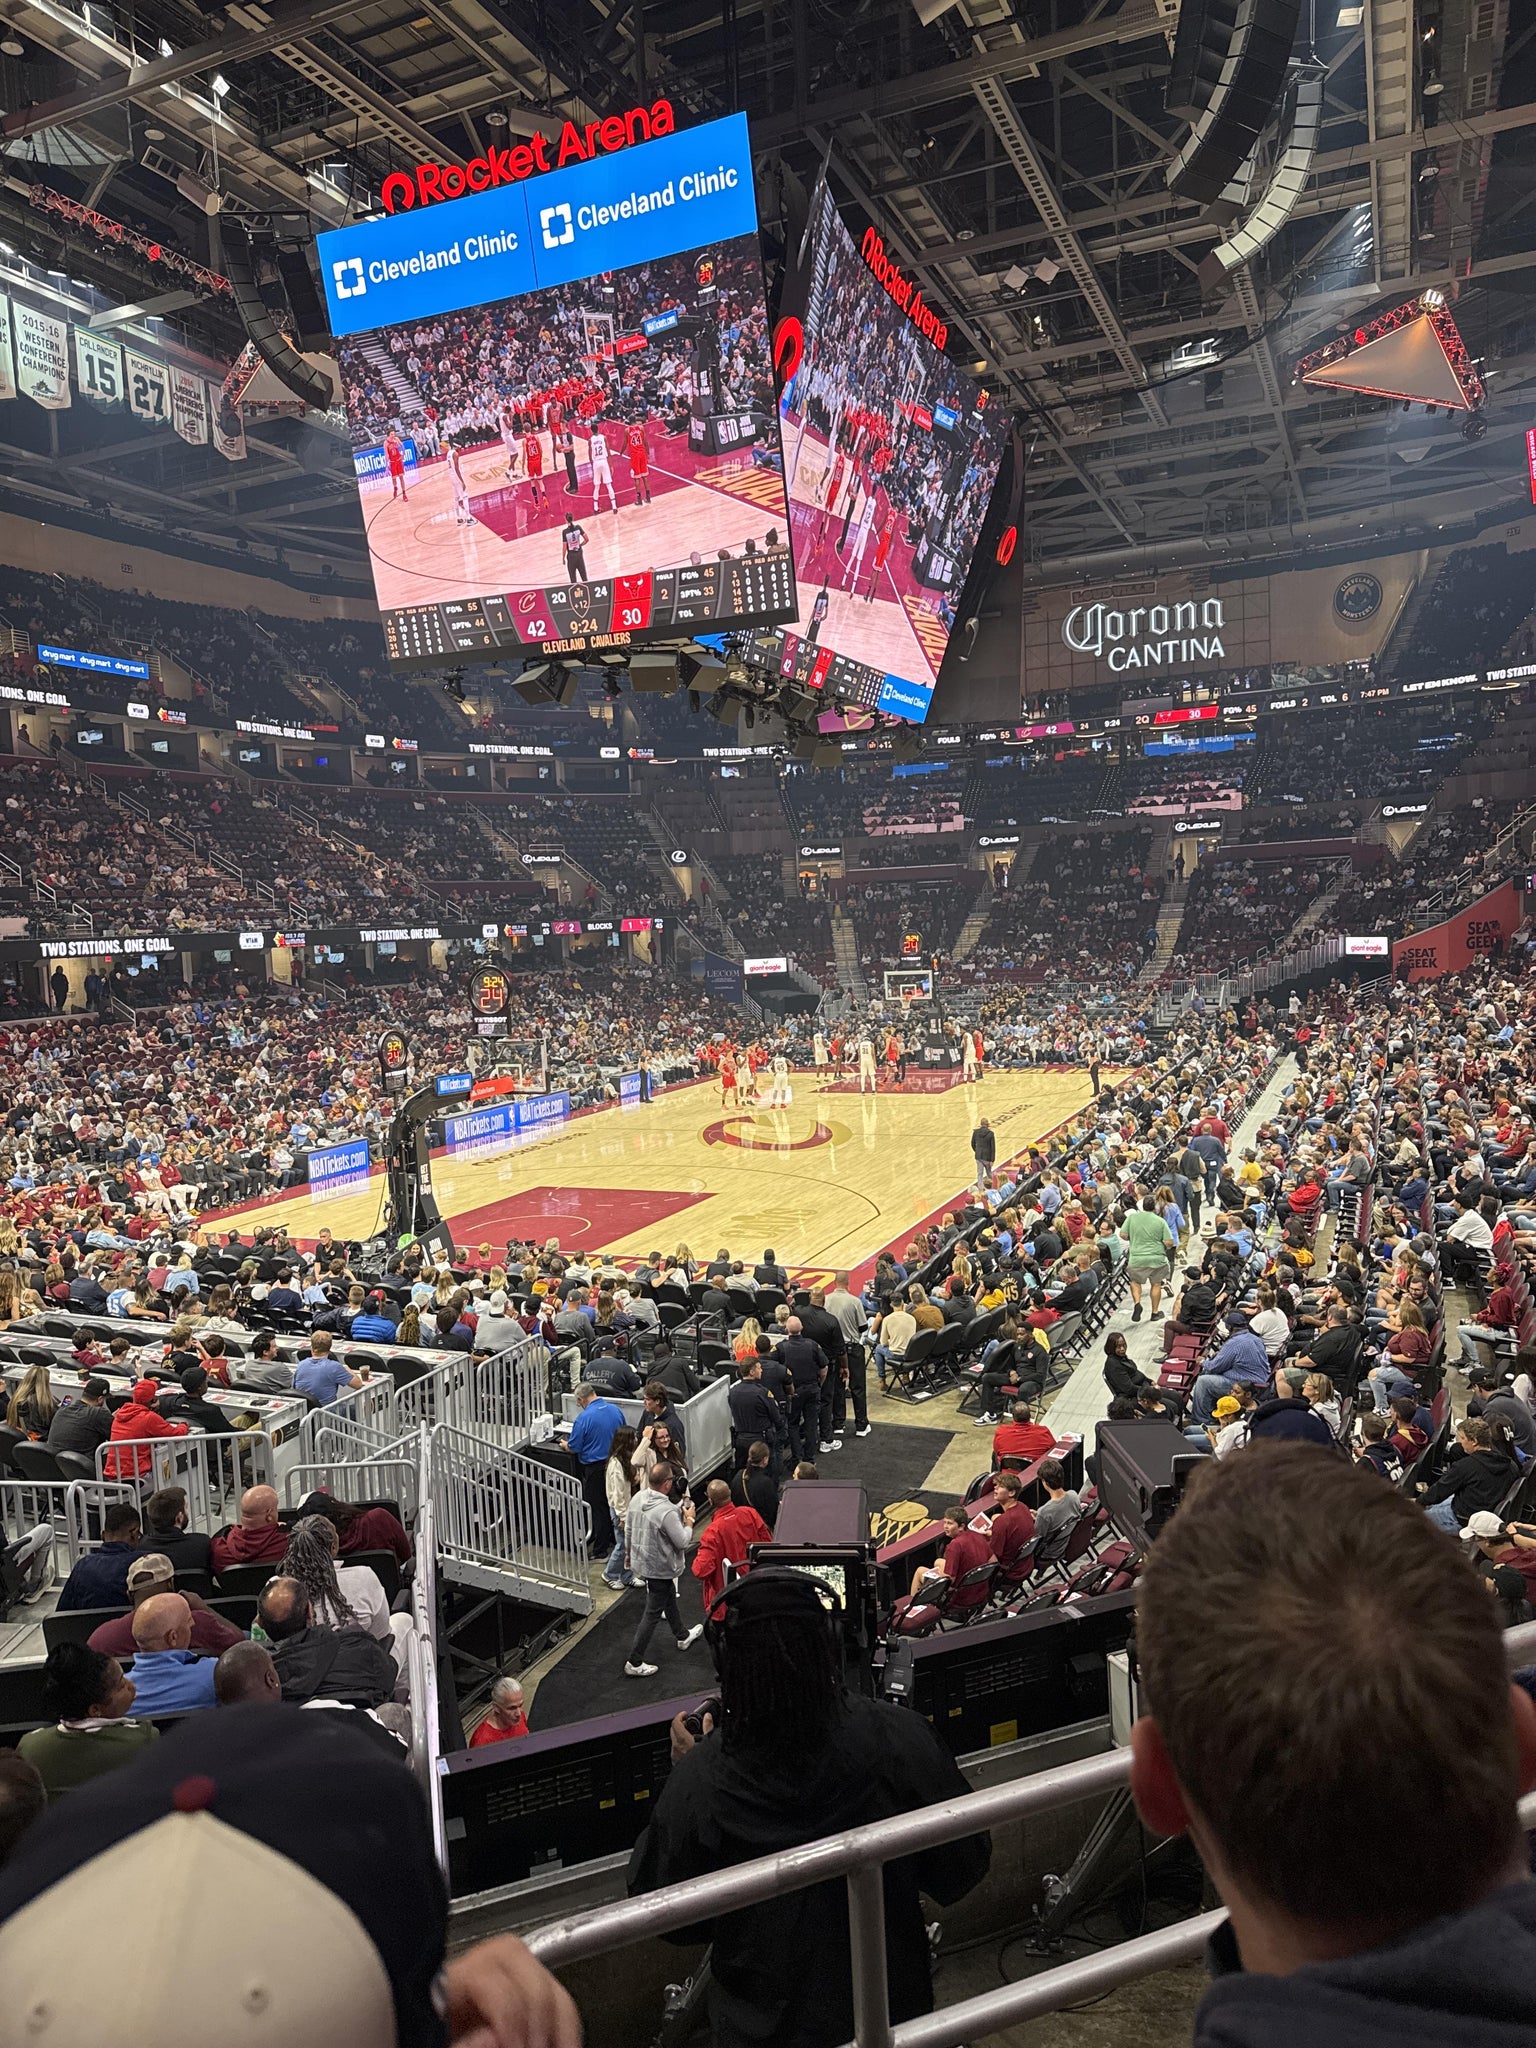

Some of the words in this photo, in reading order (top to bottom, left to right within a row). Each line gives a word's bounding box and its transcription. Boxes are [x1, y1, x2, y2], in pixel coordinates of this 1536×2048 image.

[417, 133, 550, 206] Rocket
[557, 100, 674, 167] Arena
[577, 186, 675, 232] Cleveland
[678, 167, 738, 201] Clinic
[368, 239, 462, 285] Cleveland
[464, 229, 519, 259] Clinic
[870, 237, 913, 311] Rocket
[908, 290, 948, 350] Arena
[22, 315, 59, 337] 2015-16
[24, 330, 60, 353] WESTERN
[20, 342, 66, 368] CONFERENCE
[80, 337, 117, 360] CALLANDER
[23, 356, 65, 380] CHAMPIONS
[85, 354, 116, 397] 15
[134, 374, 164, 416] 27
[681, 572, 699, 580] FG%
[704, 568, 714, 577] 45
[704, 587, 714, 595] 33
[1341, 578, 1374, 591] CLEVELAND
[552, 592, 566, 604] 2Q
[594, 586, 608, 597] 24
[661, 589, 668, 600] 2
[468, 603, 477, 611] 55
[574, 600, 588, 608] +12
[497, 612, 502, 622] 1
[622, 608, 641, 625] 30
[678, 610, 694, 618] TOL
[704, 607, 710, 615] 6
[1342, 605, 1372, 618] MONSTERS
[527, 620, 546, 637] 42
[570, 619, 598, 634] 9:24
[1062, 598, 1226, 656] Corona
[484, 636, 489, 644] 6
[543, 638, 586, 654] CLEVELAND
[591, 632, 631, 648] CAVALIERS
[1108, 636, 1225, 671] CANTINA
[43, 650, 58, 660] drug
[60, 653, 75, 661] mart
[80, 656, 95, 666] drug
[115, 663, 129, 672] drug
[814, 672, 822, 684] 30
[1487, 669, 1506, 681] TWO
[1403, 683, 1424, 692] LET
[1441, 674, 1478, 687] KNOW.
[27, 690, 44, 702] ONE
[46, 693, 71, 706] GOAL.
[892, 689, 913, 705] Cleveland
[913, 697, 926, 709] Clinic
[1321, 694, 1337, 703] TOL
[1342, 694, 1348, 702] 6
[1360, 690, 1375, 698] 7:47
[1378, 688, 1389, 696] PM
[1245, 705, 1257, 713] 45
[1271, 700, 1296, 710] FOULS
[1135, 716, 1149, 725] 2Q
[1189, 710, 1200, 718] 30
[236, 720, 251, 732] TWO
[252, 723, 283, 736] STATIONS.
[1104, 719, 1120, 727] 9:24
[1000, 731, 1010, 739] 55
[1045, 726, 1057, 734] 42
[469, 744, 485, 752] TWO
[486, 745, 519, 754] STATIONS.
[1394, 805, 1427, 814] LEXUS
[360, 930, 376, 941] TWO
[377, 929, 409, 941] STATIONS.
[410, 930, 423, 939] ONE
[424, 928, 442, 939] GOAL.
[569, 924, 574, 932] 2
[40, 942, 67, 957] TWO
[69, 940, 123, 956] STATIONS.
[124, 940, 145, 953] ONE
[146, 938, 174, 952] GOAL.
[904, 942, 918, 953] 24
[1407, 948, 1436, 958] SEAT
[1407, 958, 1437, 968] GEEK
[484, 977, 504, 987] 9:24
[481, 989, 502, 1008] 24
[388, 1042, 401, 1051] 9:24
[388, 1050, 399, 1065] 24
[520, 1099, 563, 1122] NBATickets.com
[454, 1113, 504, 1140] NBATickets.com
[310, 1152, 365, 1179] NBATickets.com
[1004, 1286, 1018, 1300] 45
[586, 1370, 616, 1380] GALLERY
